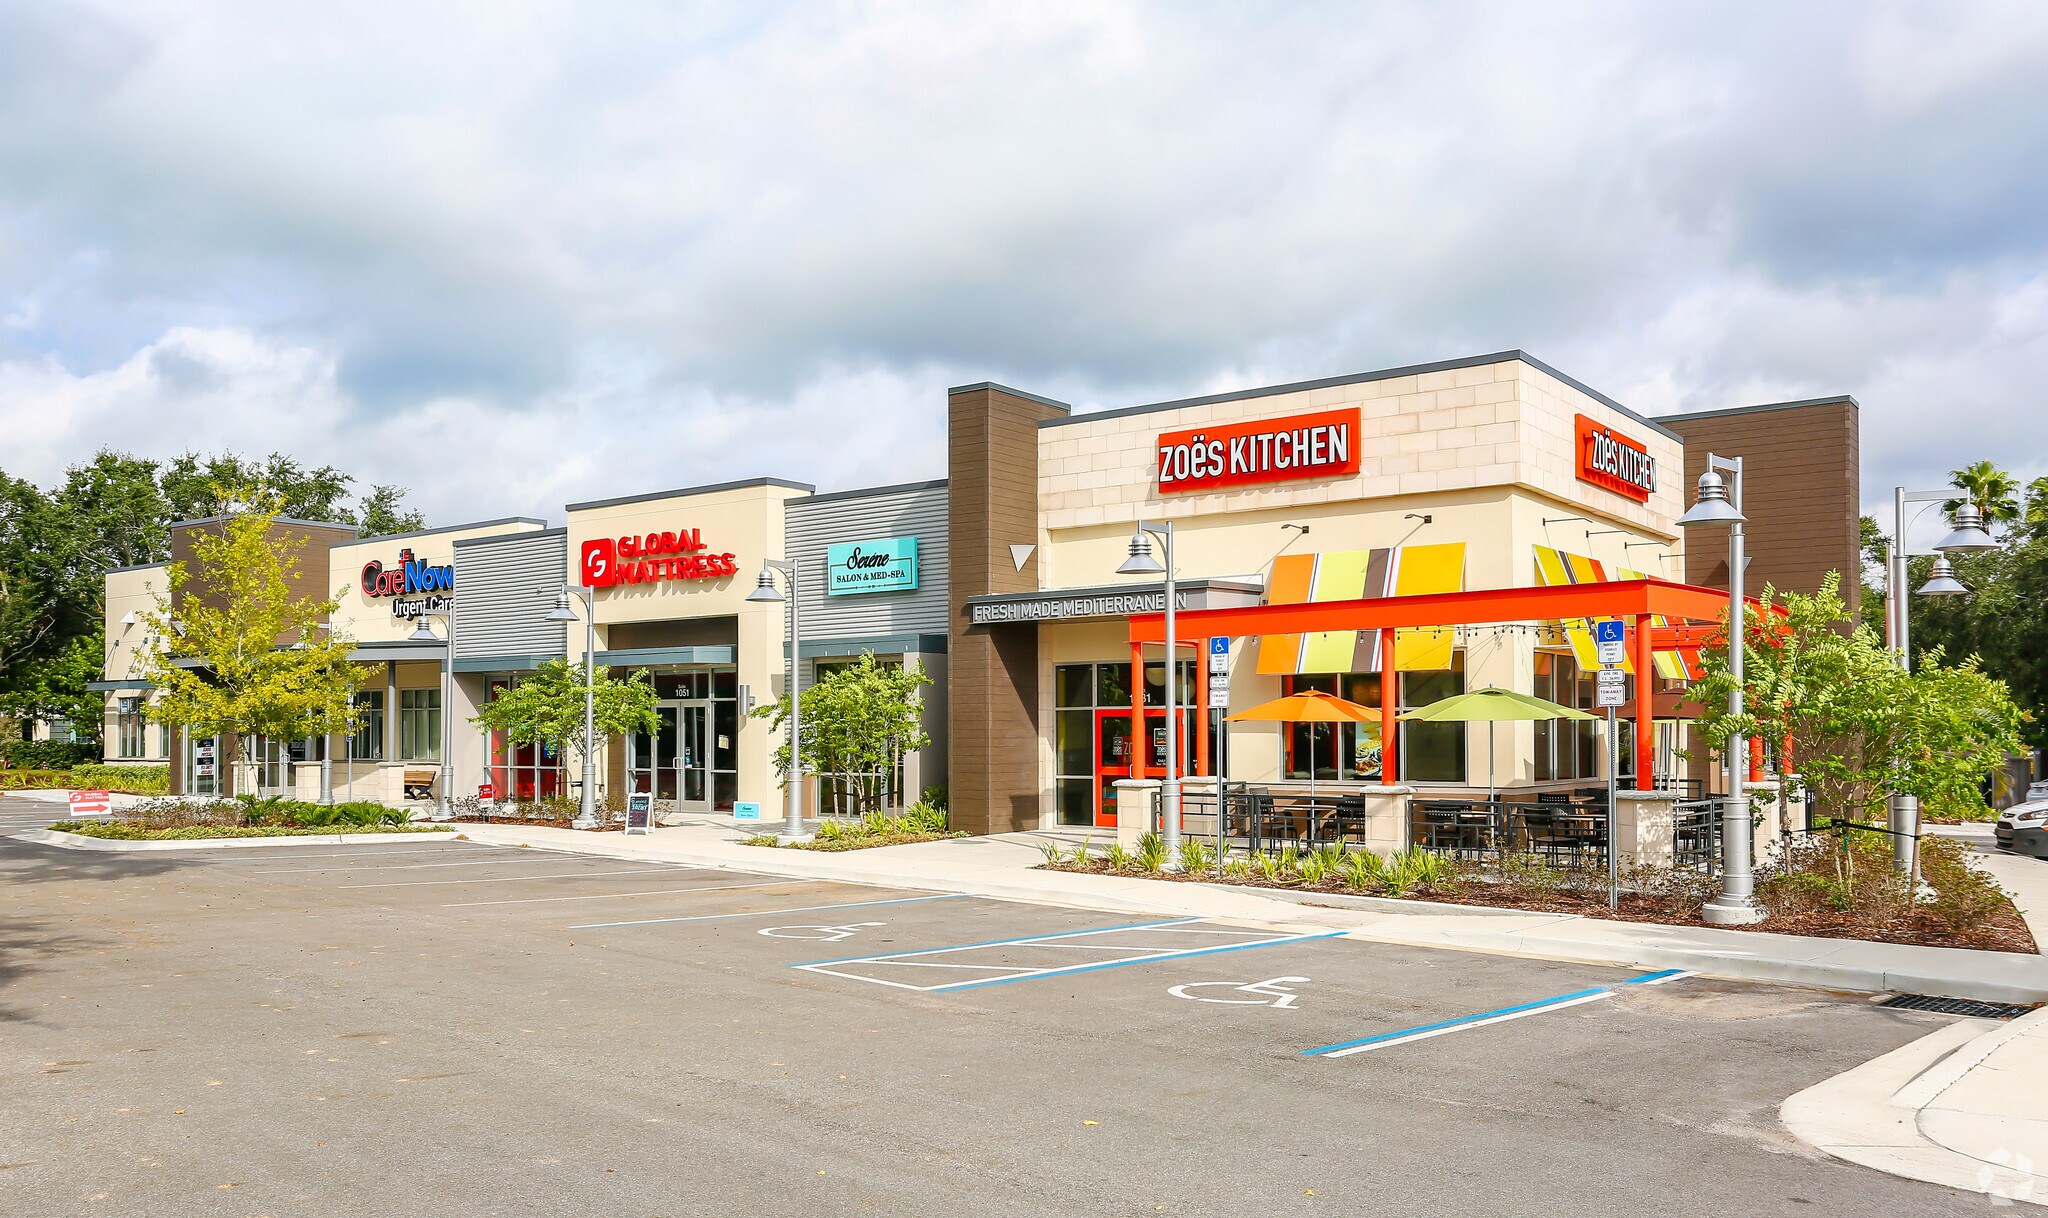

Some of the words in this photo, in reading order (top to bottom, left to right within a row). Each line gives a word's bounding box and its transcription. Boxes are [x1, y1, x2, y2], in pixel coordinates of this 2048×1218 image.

[1230, 423, 1348, 474] KITCHEN
[1618, 441, 1656, 493] KITCHEN
[617, 528, 707, 558] GLOBAL
[361, 559, 454, 597] CareNow
[617, 552, 737, 585] MATTRESS
[836, 573, 862, 583] SALON
[863, 573, 869, 581] &
[870, 569, 906, 581] MED-SPA
[391, 598, 427, 619] Urgent
[430, 596, 454, 612] Care
[974, 603, 1017, 622] FRESH
[1020, 600, 1060, 619] MADE
[1063, 592, 1187, 616] MEDITERRANEN
[675, 688, 690, 697] 1051
